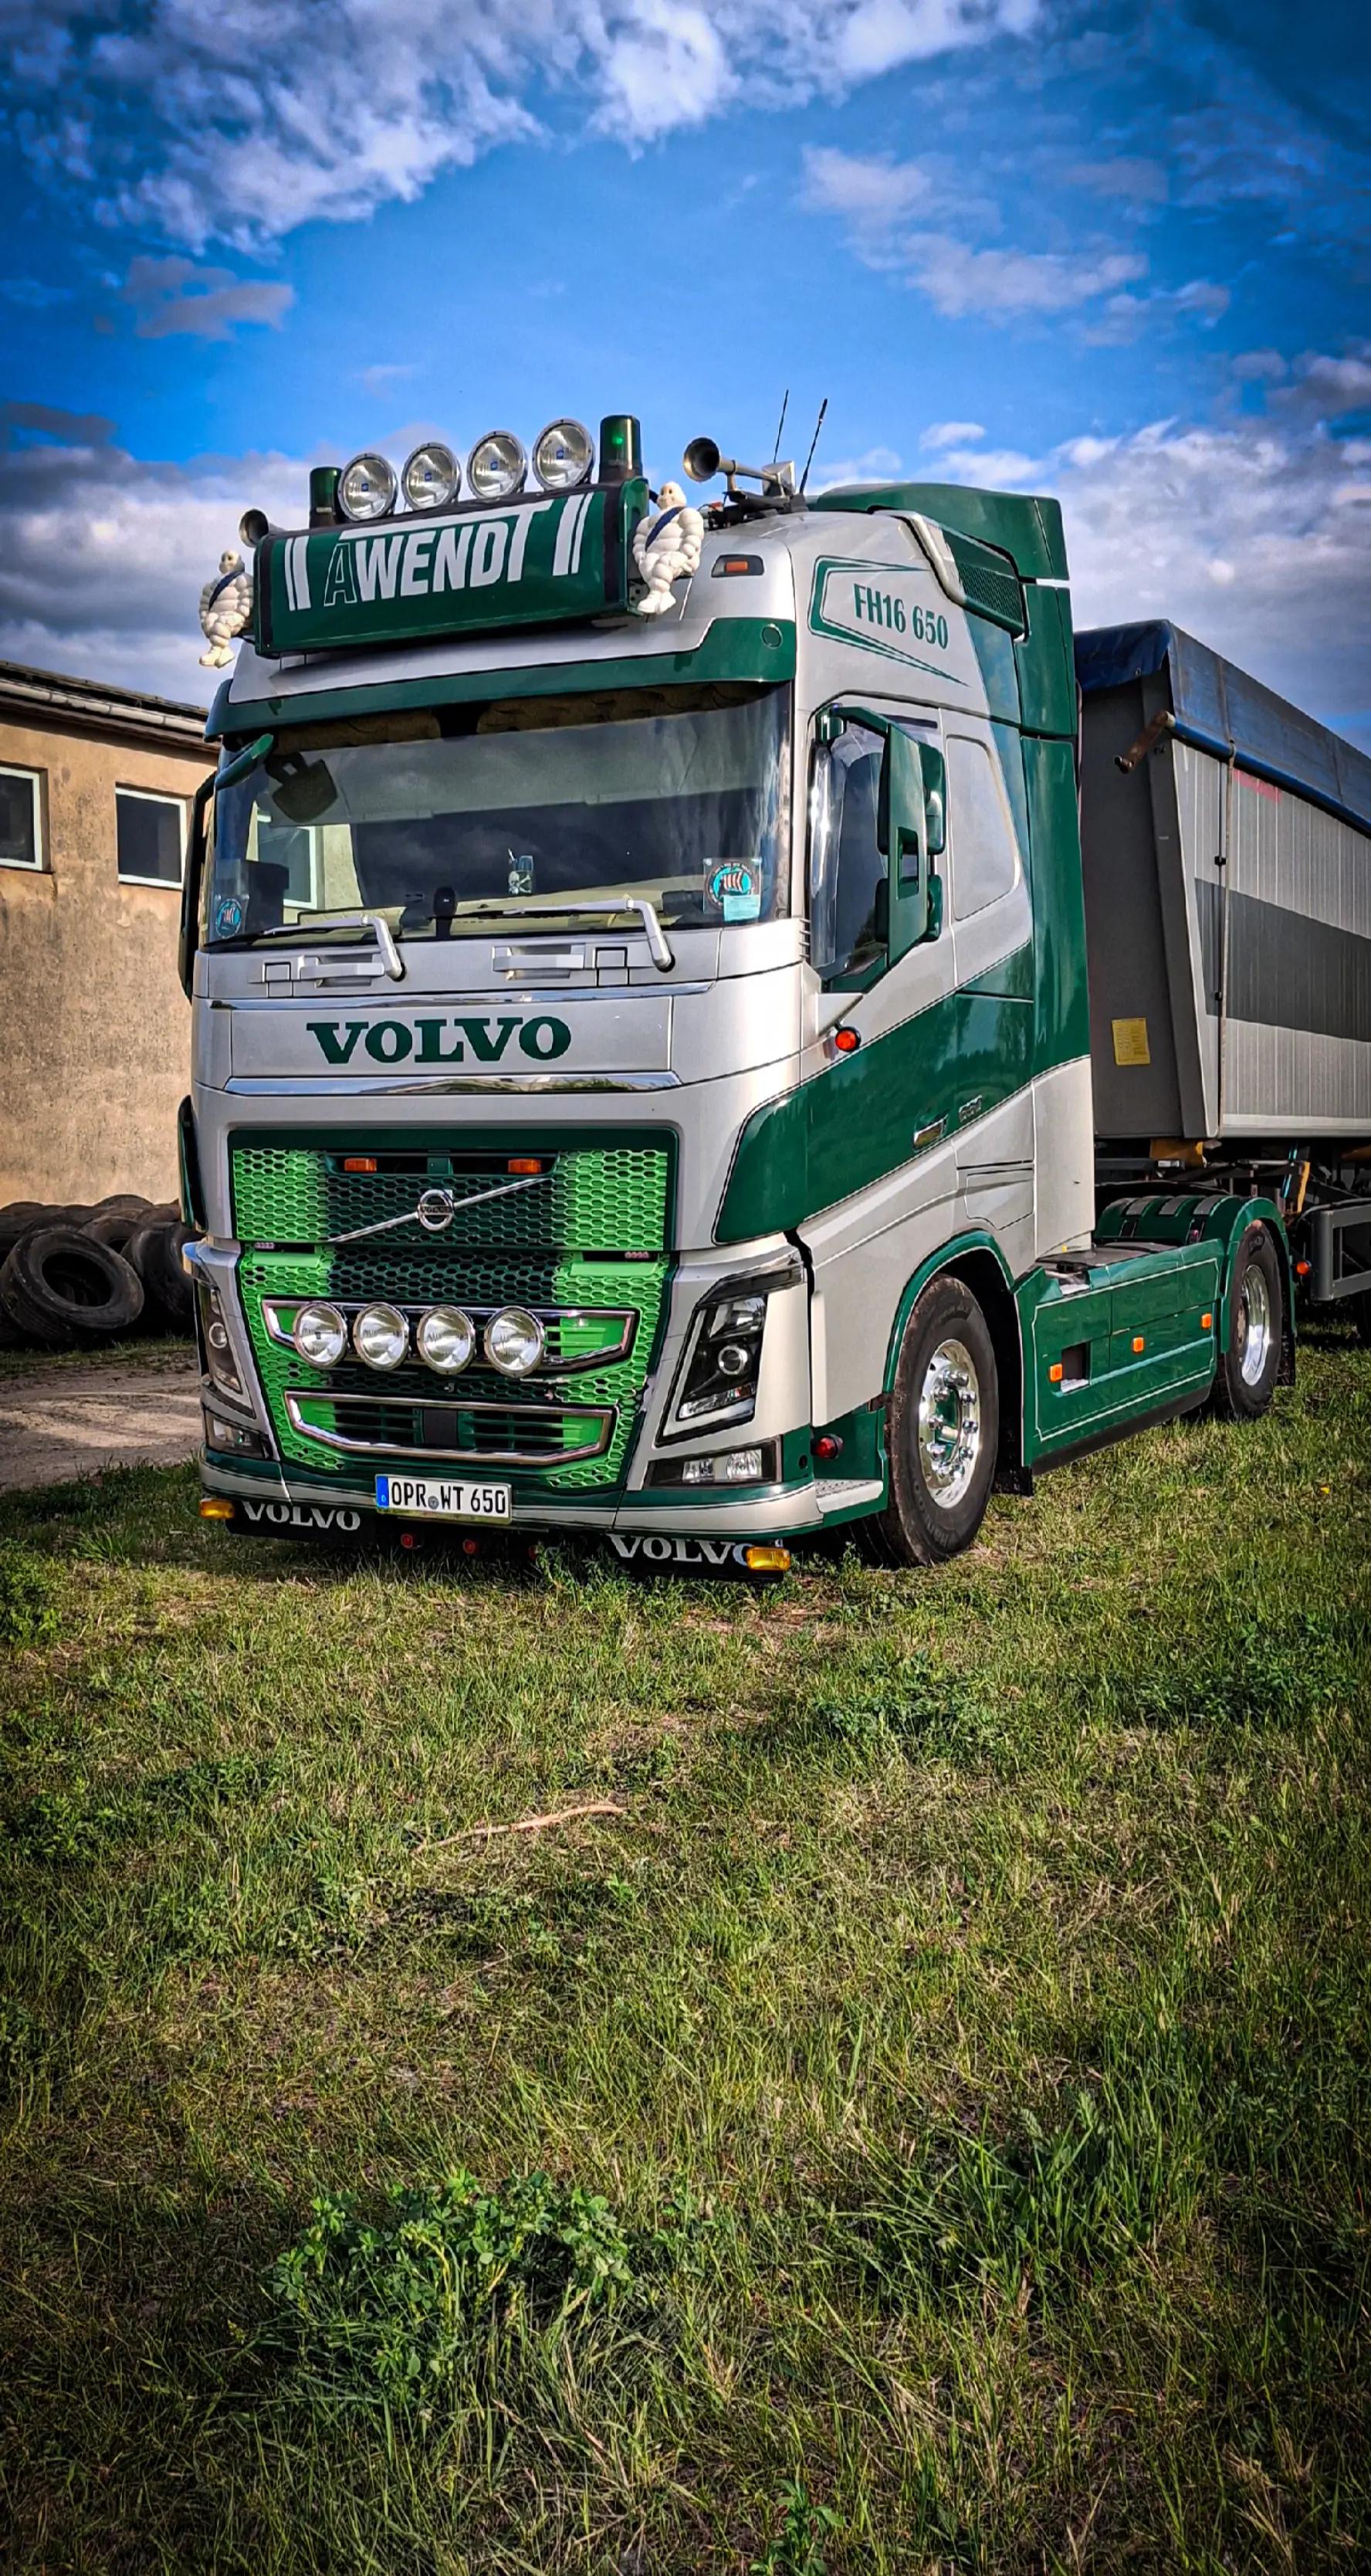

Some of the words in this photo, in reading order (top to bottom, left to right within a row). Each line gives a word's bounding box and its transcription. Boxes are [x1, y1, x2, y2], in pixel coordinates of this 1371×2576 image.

[323, 499, 554, 607] AWENDT
[853, 583, 907, 633] FH16
[912, 605, 949, 649] 650
[306, 1015, 571, 1064] VOLVO
[241, 1500, 361, 1530] VOLVO
[391, 1481, 427, 1507] OPR
[440, 1485, 464, 1510] WT
[470, 1488, 506, 1514] 650
